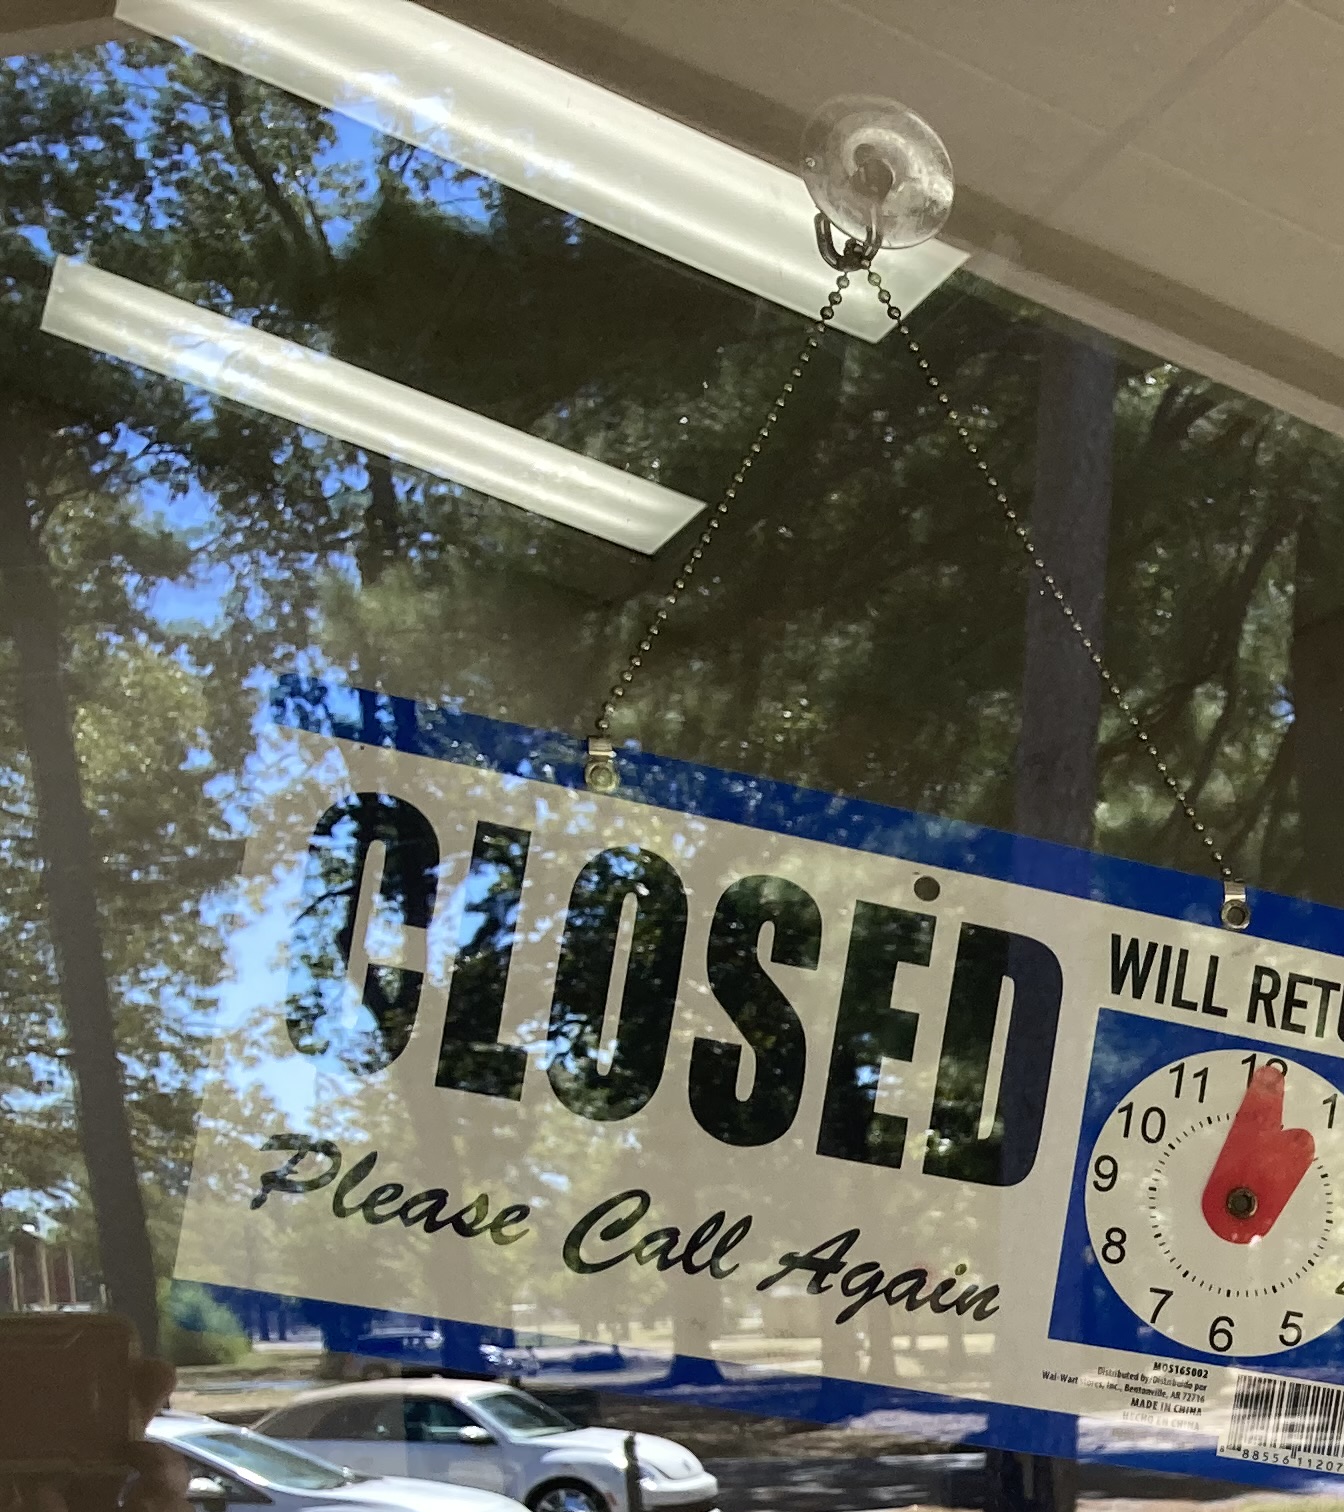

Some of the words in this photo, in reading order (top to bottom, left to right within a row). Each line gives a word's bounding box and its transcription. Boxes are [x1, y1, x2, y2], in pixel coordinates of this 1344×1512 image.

[287, 792, 1063, 1188] CLOSED
[1110, 932, 1228, 1018] WILL
[1169, 1063, 1209, 1103] 11
[1117, 1101, 1166, 1144] 10
[1323, 1093, 1338, 1129] 1
[1093, 1155, 1118, 1191] 9
[250, 1133, 532, 1246] Please
[562, 1188, 753, 1280] Call
[756, 1228, 1003, 1324] Again
[1102, 1227, 1127, 1264] 8
[1149, 1288, 1173, 1324] 7
[1209, 1316, 1233, 1352] 6
[1279, 1311, 1303, 1347] 5
[1097, 1366, 1139, 1381] Distributed
[1131, 1398, 1158, 1410] MADE
[1160, 1402, 1171, 1412] IN
[1173, 1404, 1202, 1416] CHINA
[1242, 1450, 1290, 1465] 88556
[1298, 1457, 1343, 1472] 11207
